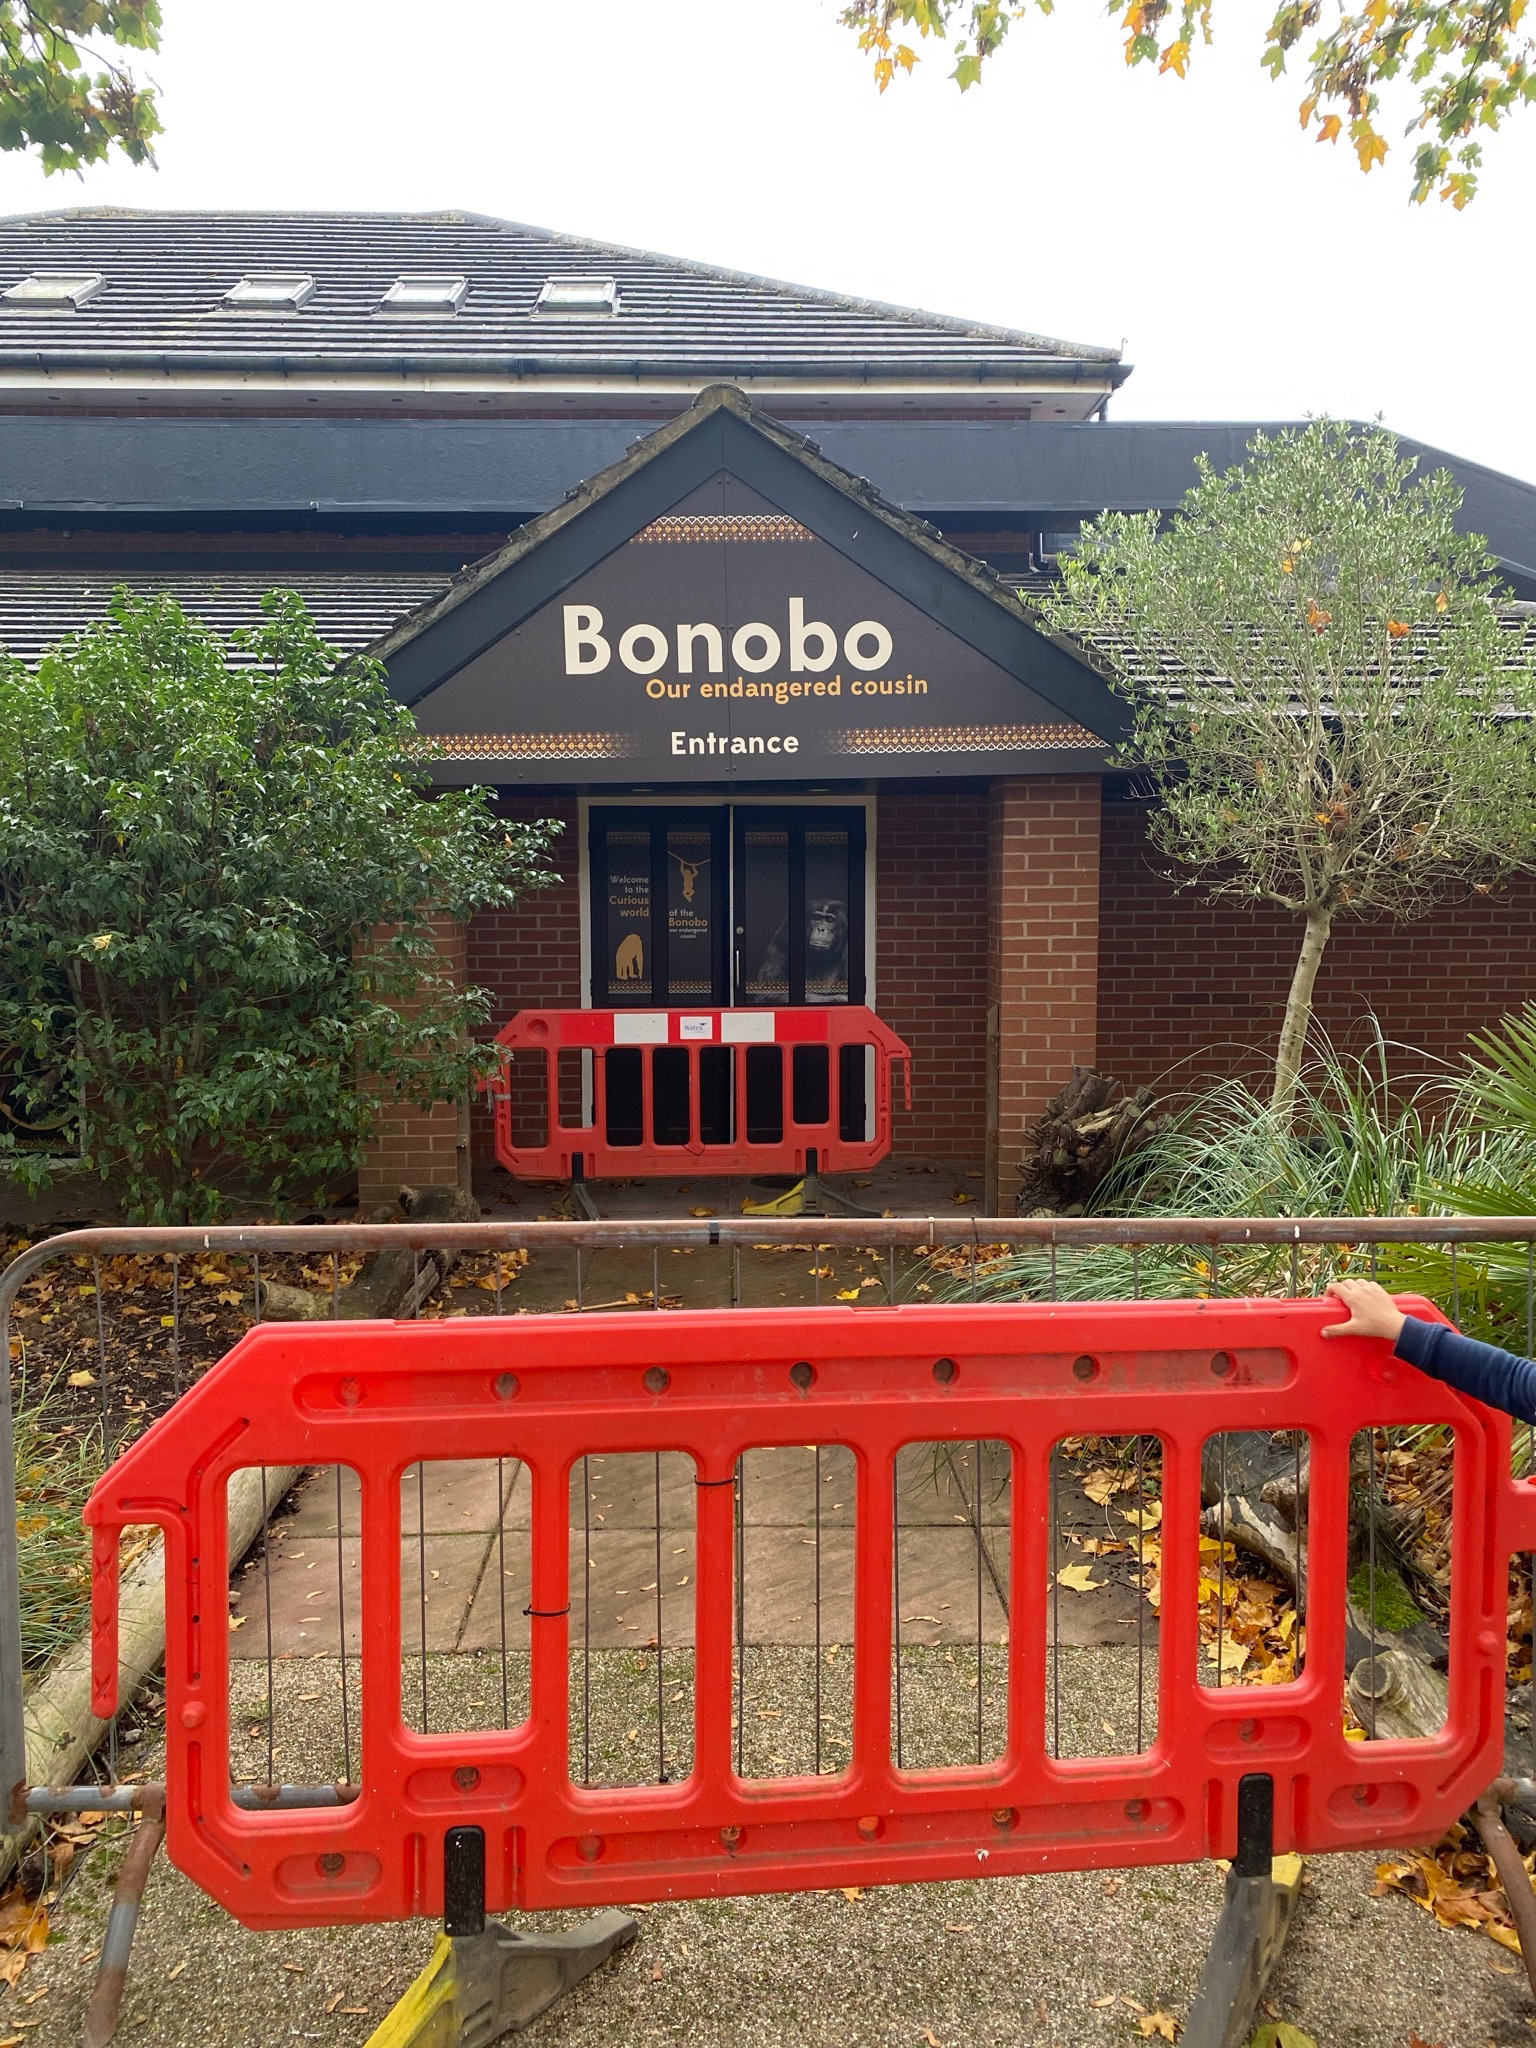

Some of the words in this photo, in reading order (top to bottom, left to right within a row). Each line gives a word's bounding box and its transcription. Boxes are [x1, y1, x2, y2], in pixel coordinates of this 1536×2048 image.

[563, 597, 893, 675] Bonobo
[646, 678, 691, 699] Our
[700, 675, 842, 705] endangered
[850, 674, 928, 695] cousin
[671, 731, 799, 755] Entrance
[610, 875, 649, 884] Welcome
[624, 886, 633, 894] to
[636, 885, 650, 894] the
[609, 895, 650, 905] Curious
[620, 907, 650, 917] world
[669, 908, 678, 917] of
[680, 908, 694, 917] the
[668, 917, 708, 927] Bonobo
